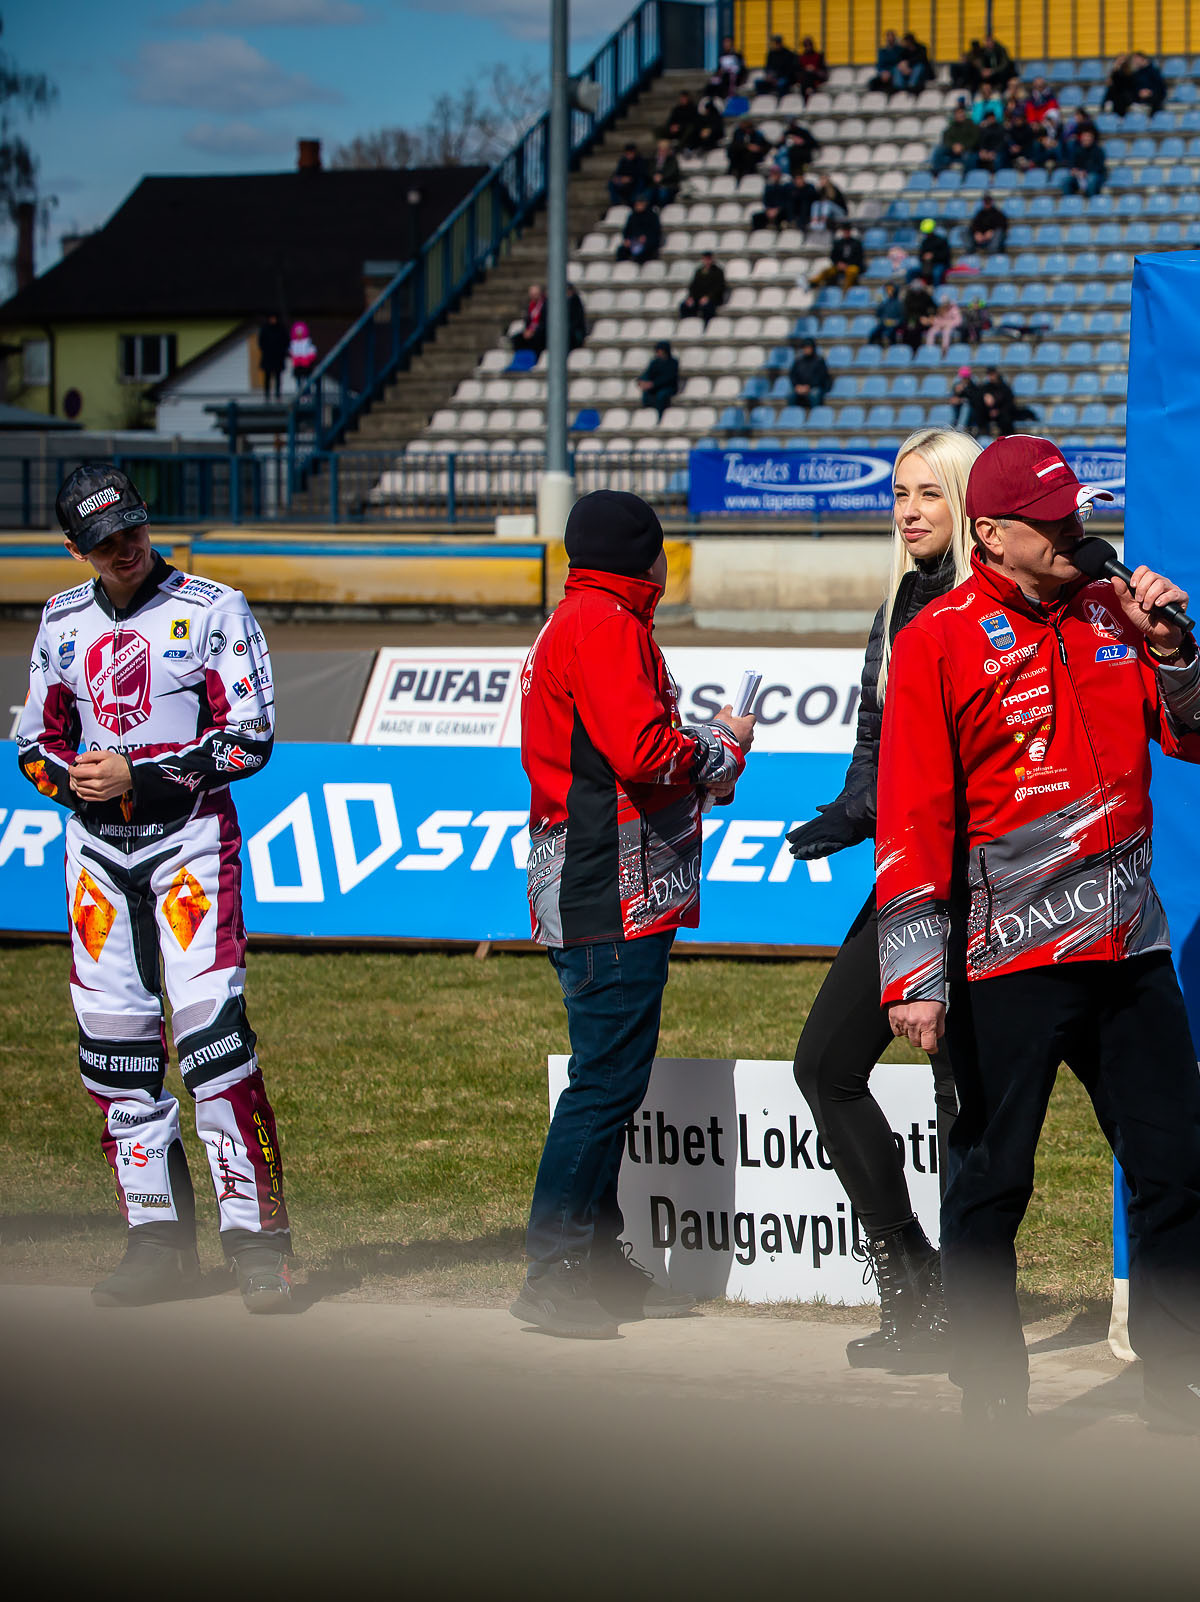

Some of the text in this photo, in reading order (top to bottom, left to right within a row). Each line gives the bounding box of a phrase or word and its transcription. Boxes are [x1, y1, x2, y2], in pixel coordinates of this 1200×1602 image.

[1000, 643, 1039, 665] OPTIBET
[92, 640, 141, 692] LOKOMOTIV
[1020, 666, 1048, 681] STUDIOS
[389, 669, 511, 703] PUFAS
[1001, 685, 1050, 708] TRODO
[1006, 704, 1054, 726] SemiCom
[378, 720, 496, 736] MADE IN GERMANY
[1027, 781, 1071, 796] STOKKER
[0, 808, 63, 867] R
[99, 824, 164, 838] AMBER STUDIOS
[194, 1032, 243, 1066] STUDIOS
[109, 1055, 160, 1072] STUDIOS
